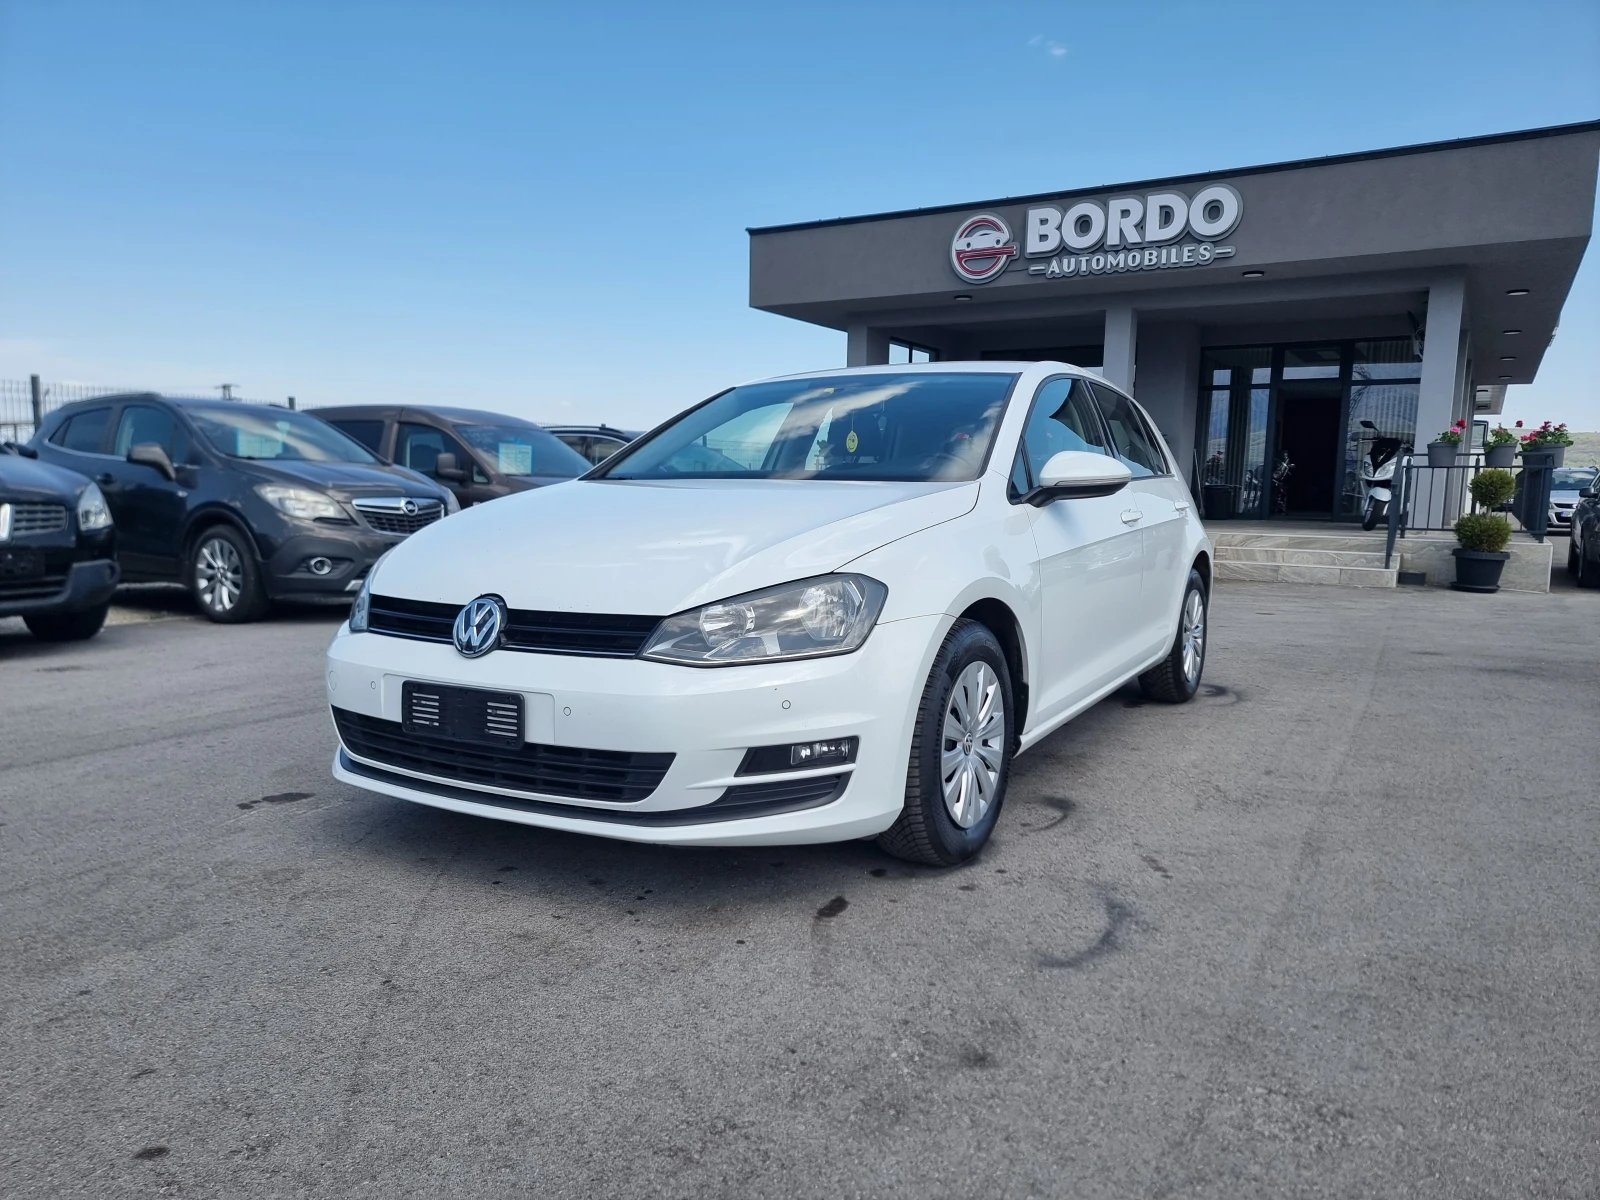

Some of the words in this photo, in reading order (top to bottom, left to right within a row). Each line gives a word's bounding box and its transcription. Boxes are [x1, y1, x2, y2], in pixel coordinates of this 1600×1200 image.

[1027, 187, 1239, 253] BORDO
[1048, 245, 1211, 274] AUTOMOBILES
[454, 599, 499, 650] VW
